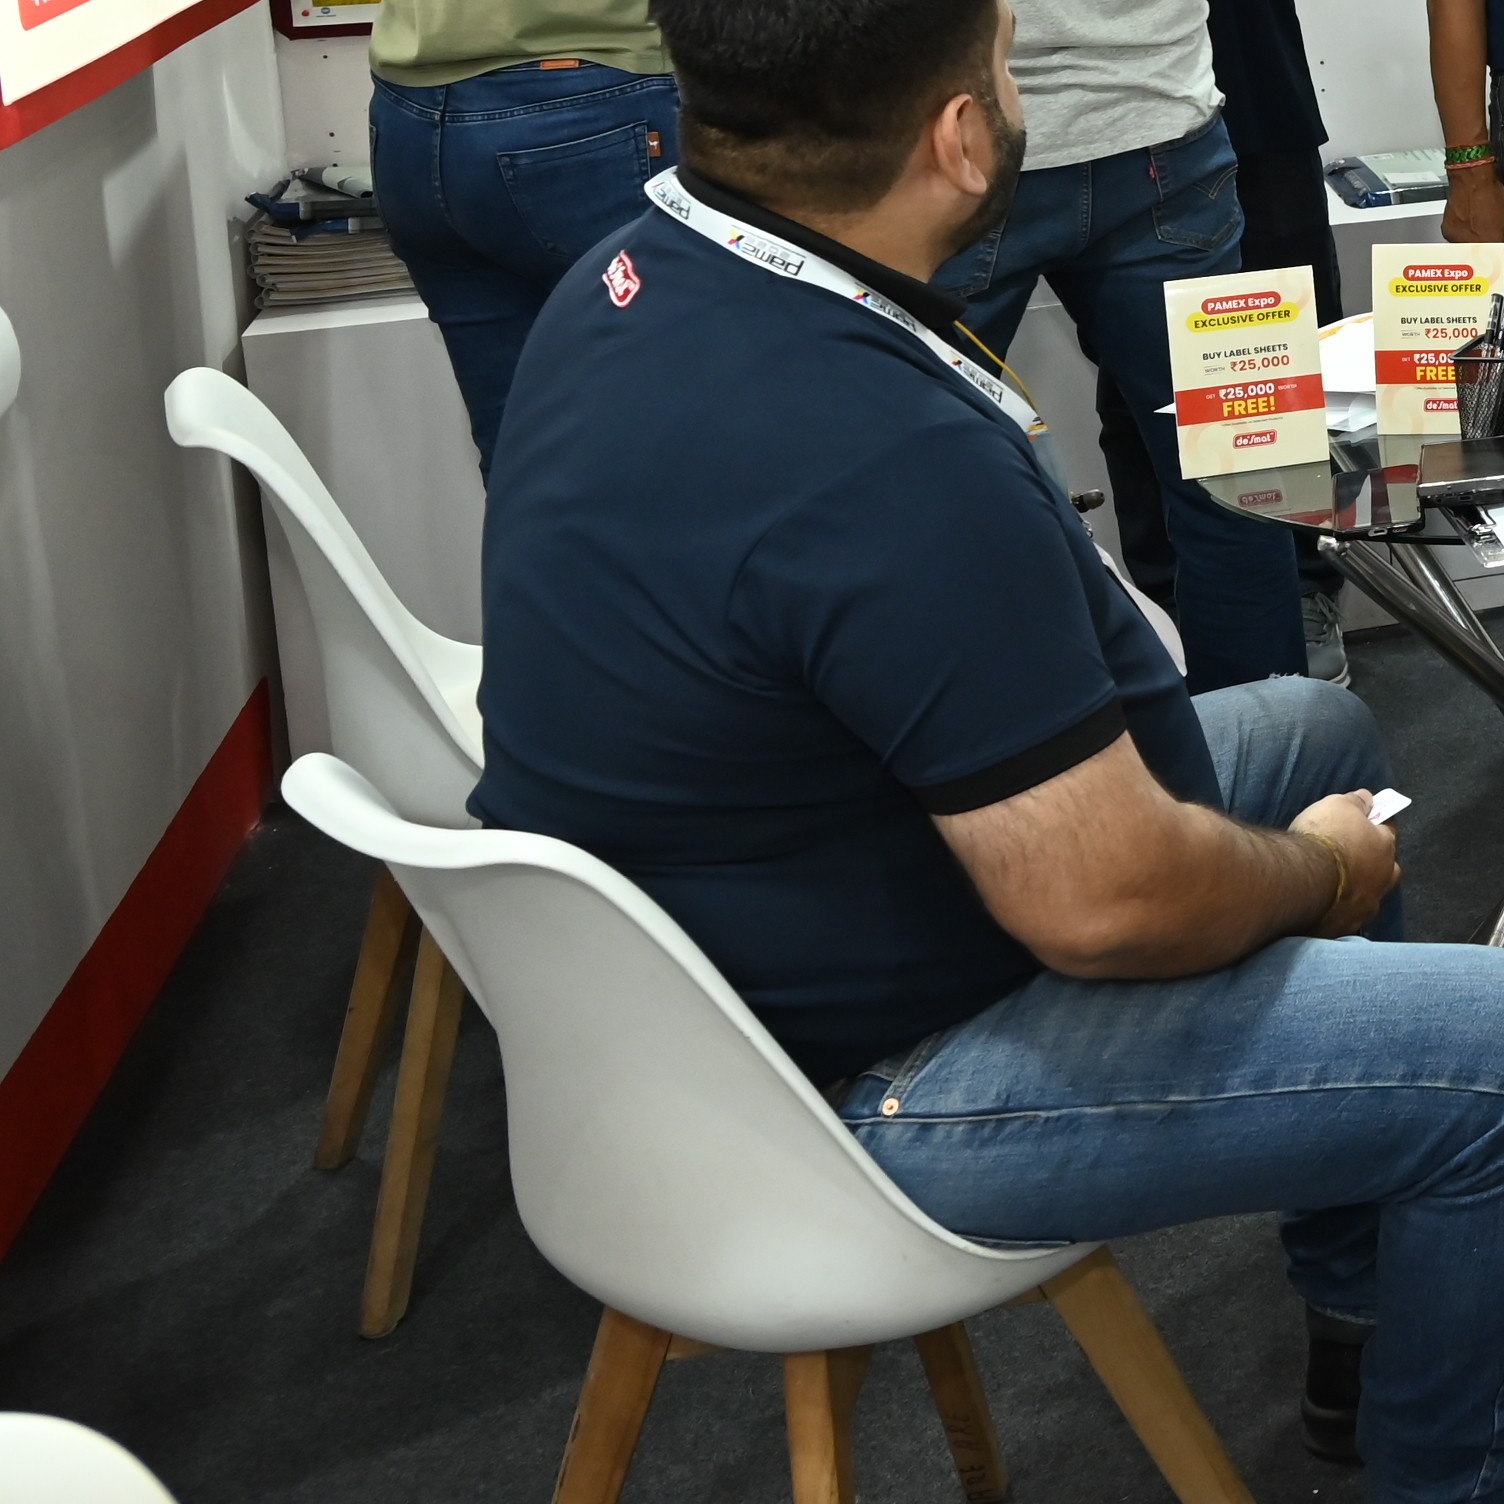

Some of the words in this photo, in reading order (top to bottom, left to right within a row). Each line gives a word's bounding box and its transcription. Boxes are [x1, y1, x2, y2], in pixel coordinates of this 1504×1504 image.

[1408, 268, 1442, 279] PAMEX
[1443, 268, 1469, 280] Expo
[1395, 283, 1449, 294] EXCLUSIVE
[1451, 282, 1482, 293] OFFER
[1207, 298, 1246, 312] PAMEX
[1247, 295, 1275, 309] Expo
[1194, 311, 1255, 329] EXCLUSIVE
[1256, 308, 1291, 323] OFFER
[1400, 317, 1417, 325] BUY
[1419, 317, 1444, 325] LABEL
[1446, 316, 1477, 324] SHEETS
[1425, 327, 1479, 340] ₹25,000
[1202, 351, 1221, 360] BUY
[1224, 347, 1252, 358] LABEL
[1253, 343, 1288, 355] SHEETS
[1413, 353, 1454, 364] ₹25,0
[1230, 354, 1291, 373] ₹25,000
[1416, 366, 1457, 382] FREE
[1219, 382, 1275, 400] ₹25,000
[1222, 395, 1276, 417] FREE!
